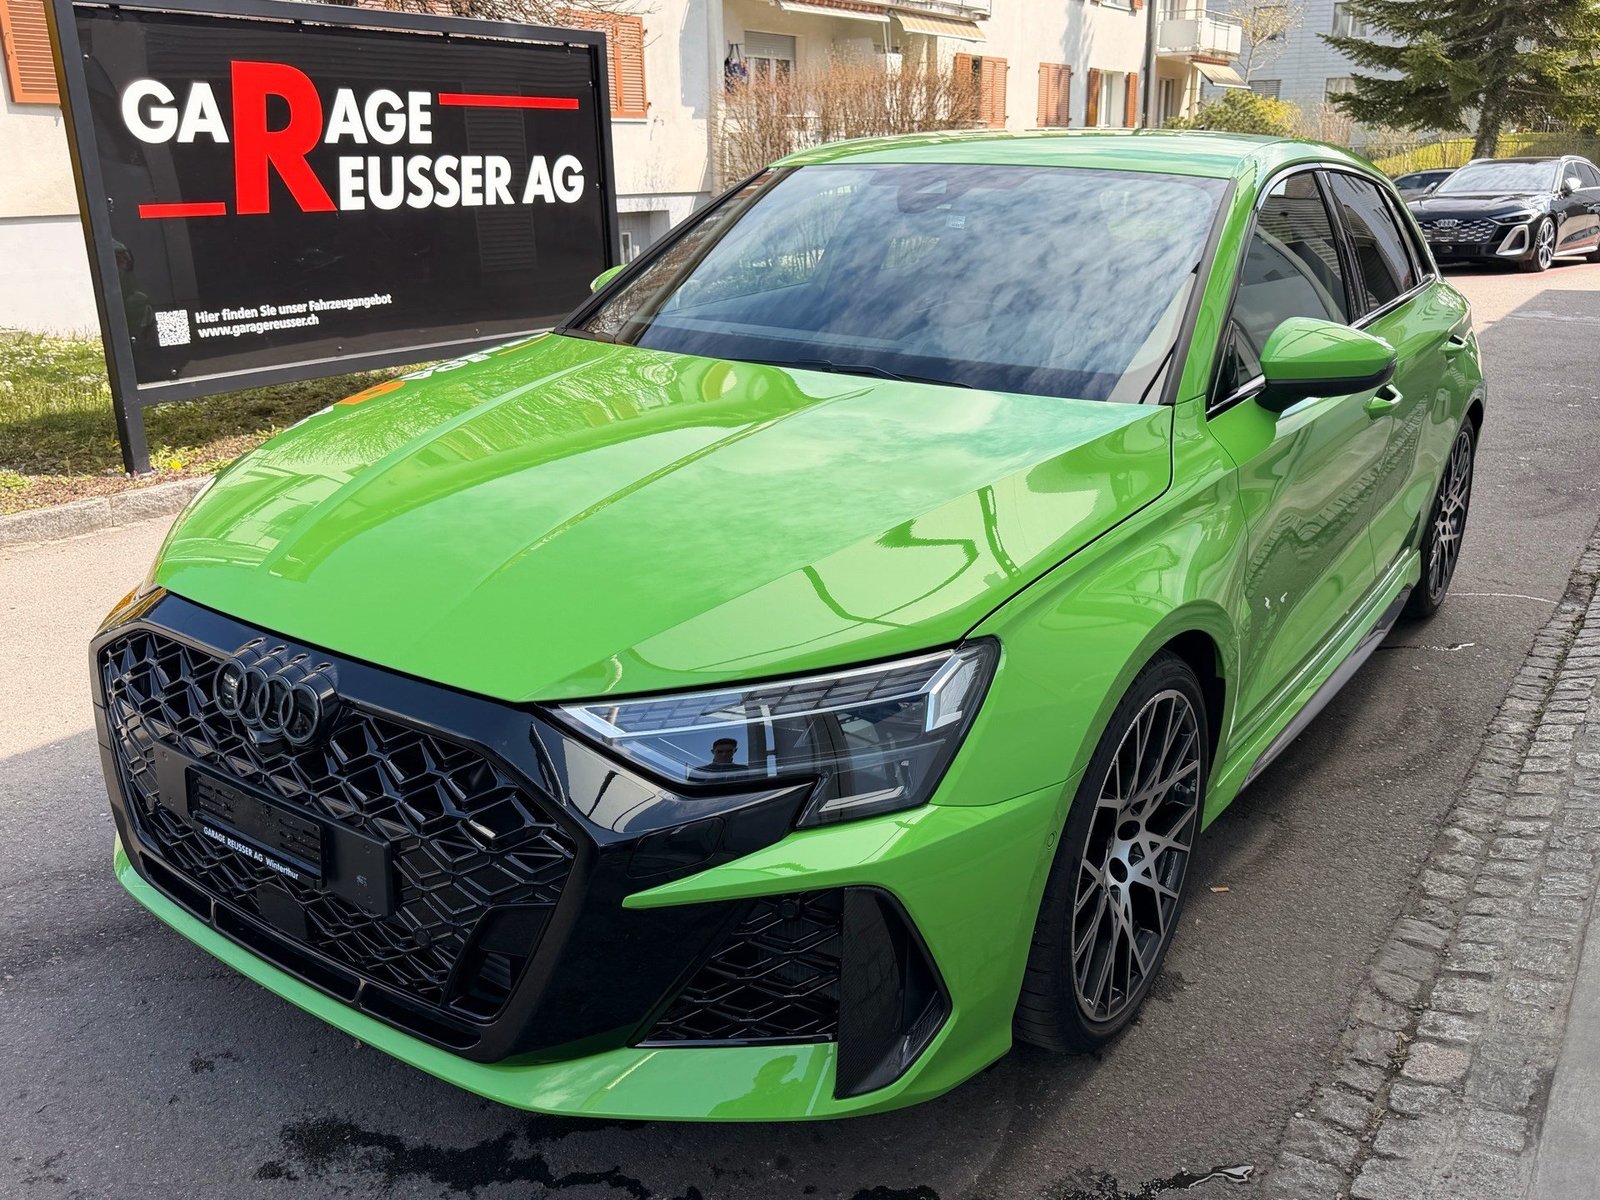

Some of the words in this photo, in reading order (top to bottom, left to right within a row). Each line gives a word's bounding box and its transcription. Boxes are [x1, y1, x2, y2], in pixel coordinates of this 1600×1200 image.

[522, 155, 585, 206] AG
[195, 310, 220, 324] Hier
[221, 306, 258, 321] finden
[259, 304, 277, 317] Sie
[278, 303, 307, 316] unser
[308, 293, 392, 312] Fahrzeugangebot
[198, 313, 320, 338] www.garagereusser.ch
[203, 826, 226, 844] GARAGE
[227, 838, 253, 858] REUSSER
[253, 851, 264, 863] AG
[265, 857, 299, 880] Winterthur
